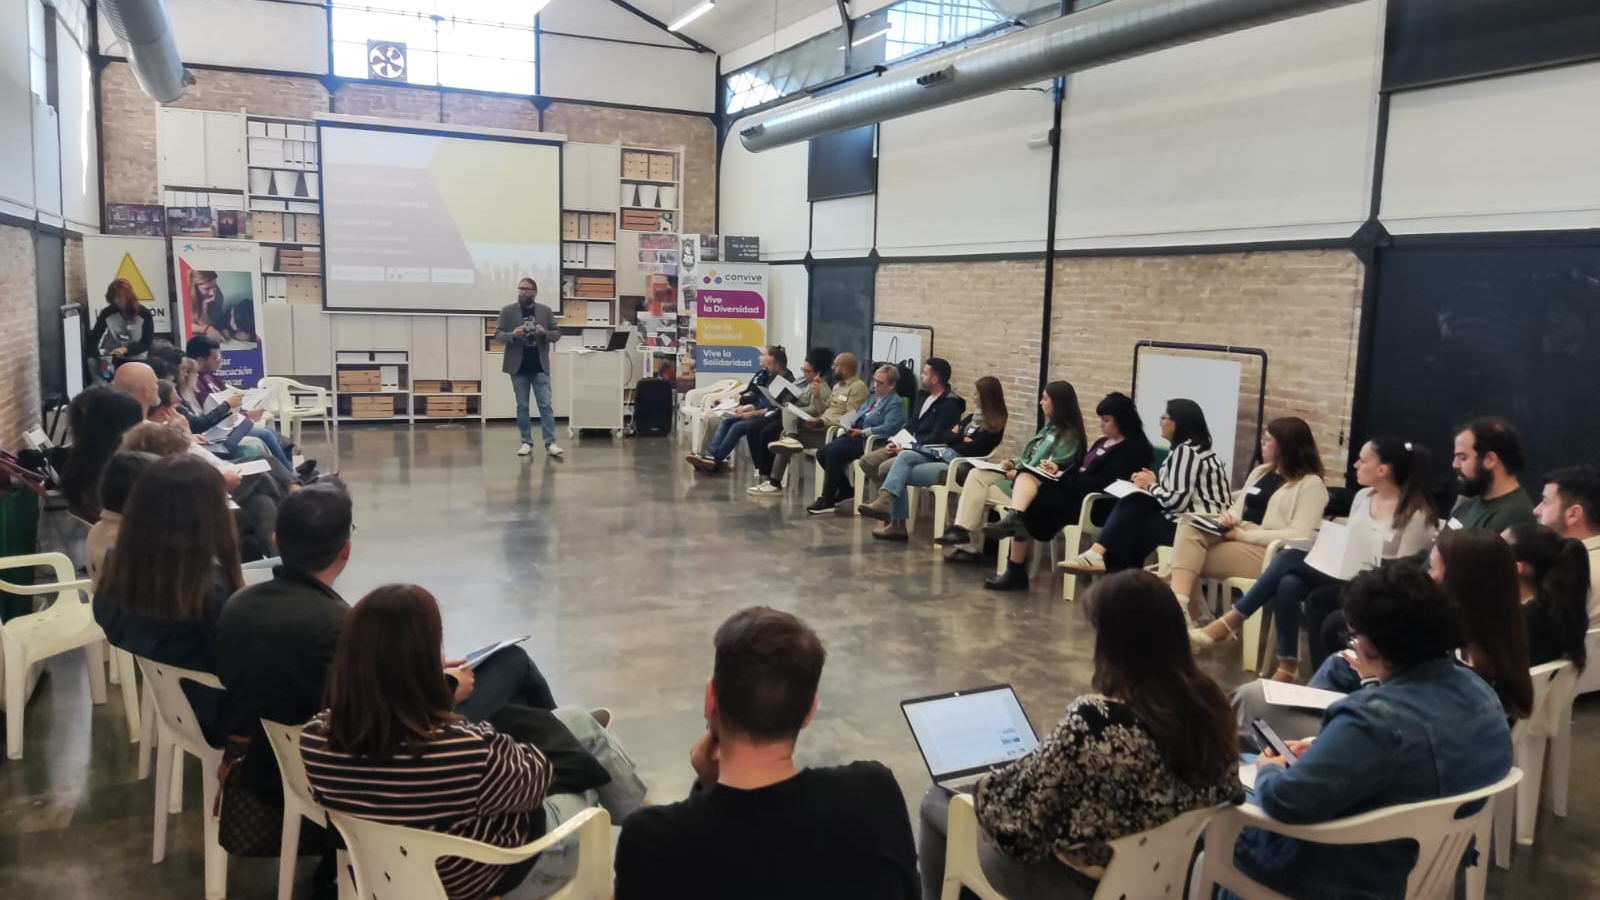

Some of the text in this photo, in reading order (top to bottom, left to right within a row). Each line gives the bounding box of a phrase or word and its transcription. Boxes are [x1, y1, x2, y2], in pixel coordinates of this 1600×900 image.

[725, 272, 762, 282] convive
[703, 295, 723, 304] Vive
[703, 304, 760, 314] la Diversidad
[703, 349, 732, 357] Vive la
[703, 358, 753, 367] Solidaridad
